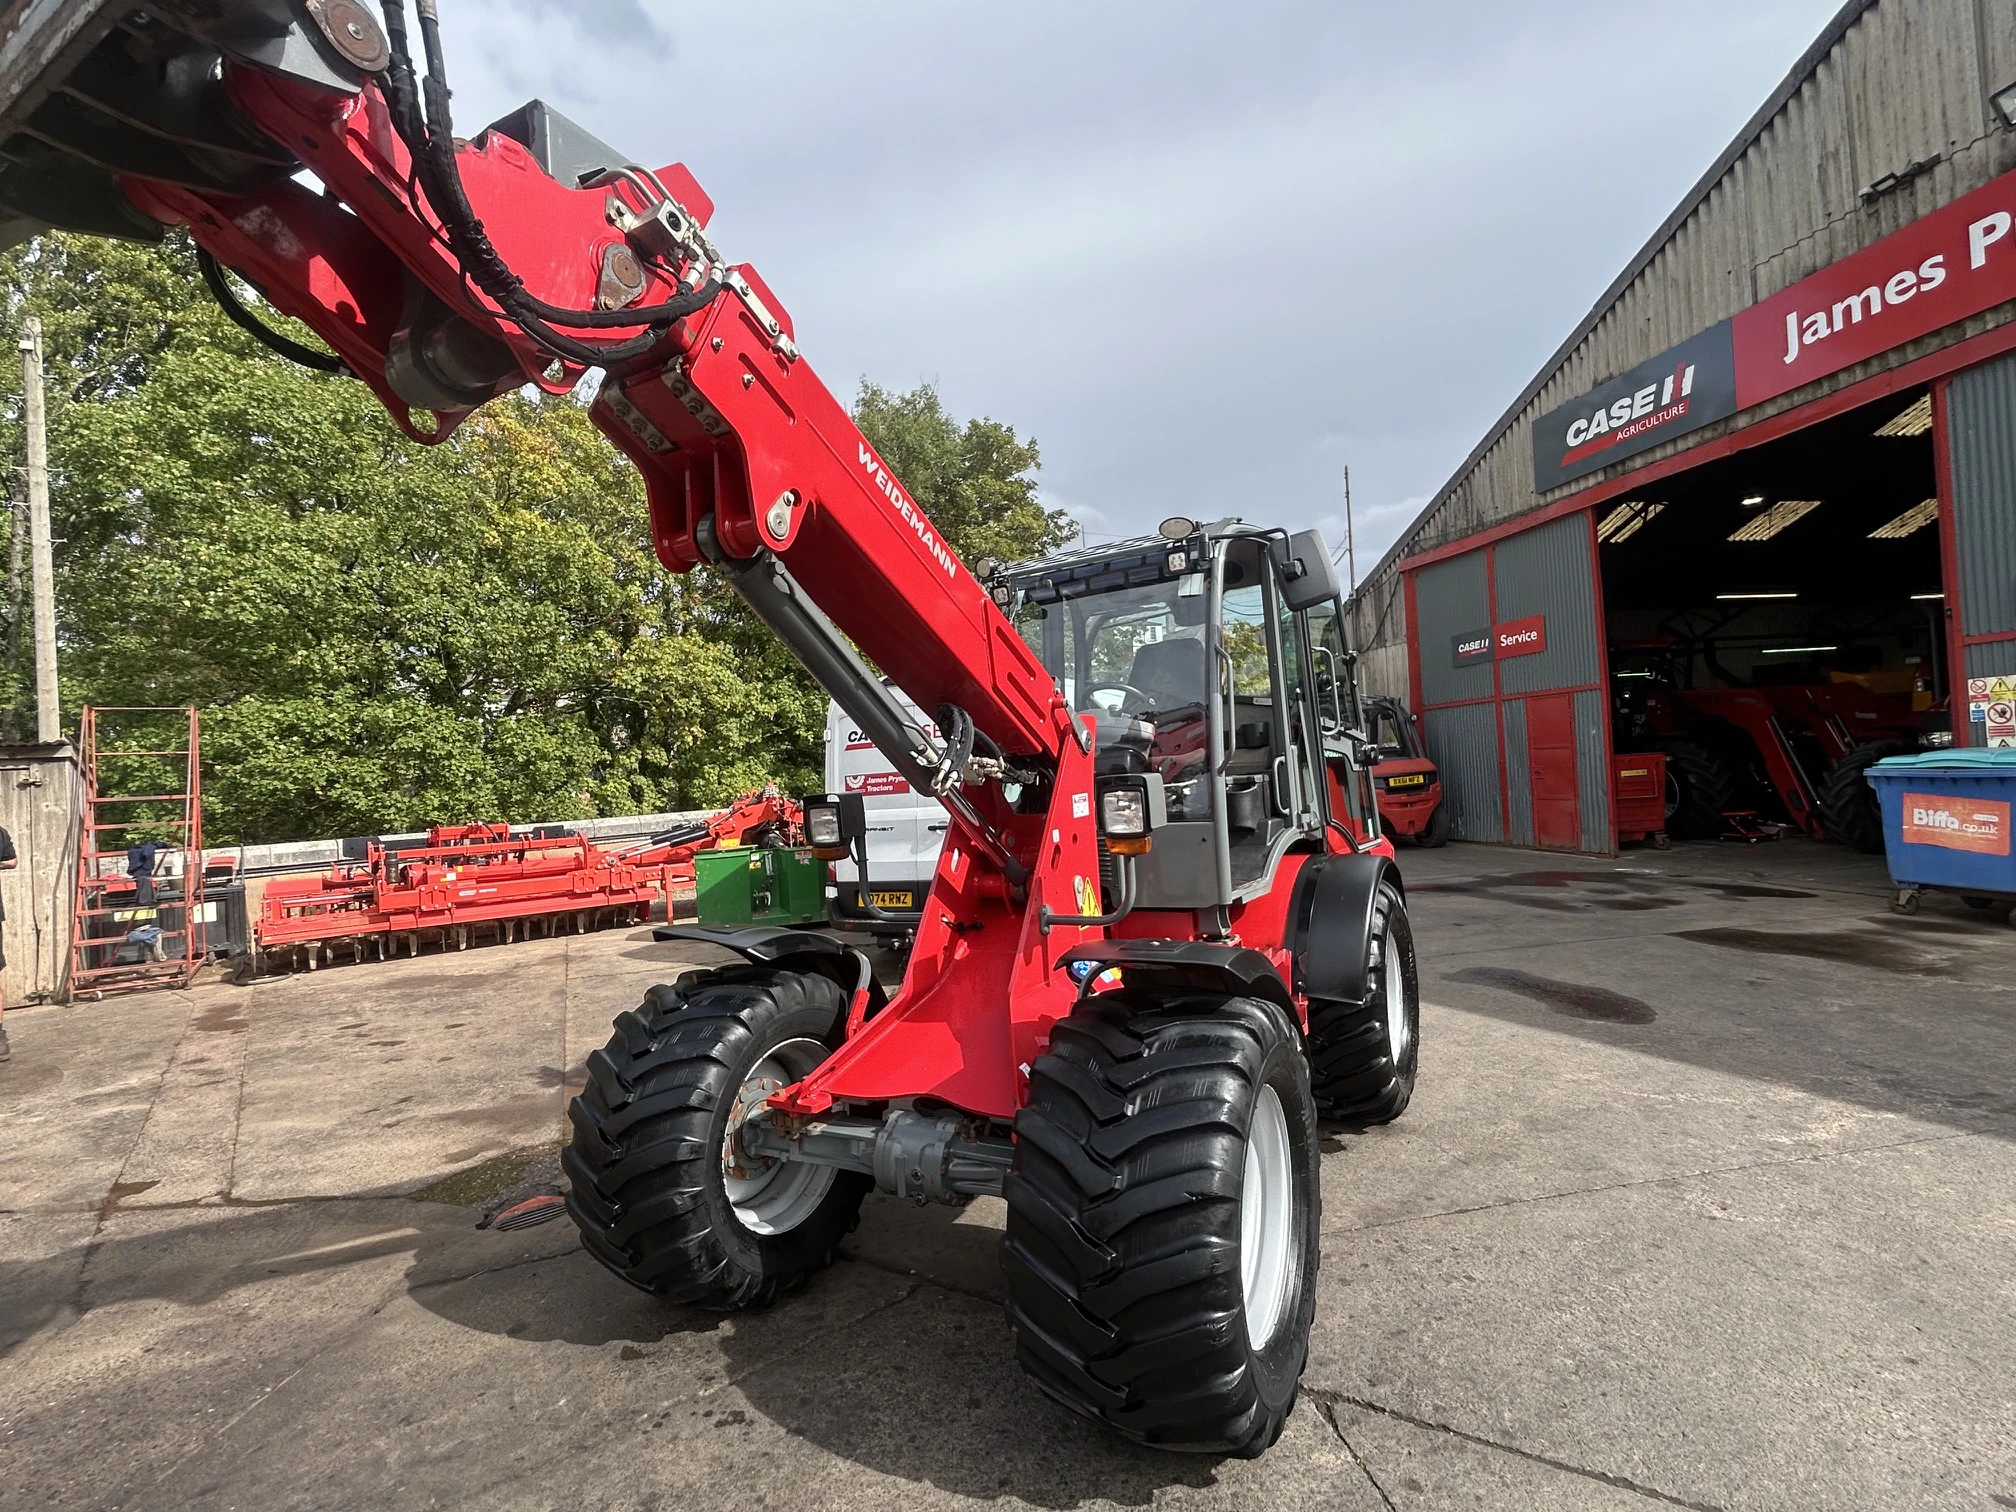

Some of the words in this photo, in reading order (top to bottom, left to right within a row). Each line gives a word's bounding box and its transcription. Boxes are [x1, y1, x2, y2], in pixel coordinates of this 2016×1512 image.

[1783, 254, 1946, 365] James
[1968, 211, 2016, 270] P
[1565, 382, 1658, 448] CASE
[1616, 402, 1686, 442] AGRICULTURE
[858, 440, 957, 579] WEIDEMANN
[1500, 629, 1538, 647] Service
[847, 730, 869, 743] CA
[866, 776, 887, 784] James
[866, 784, 894, 792] Tractors
